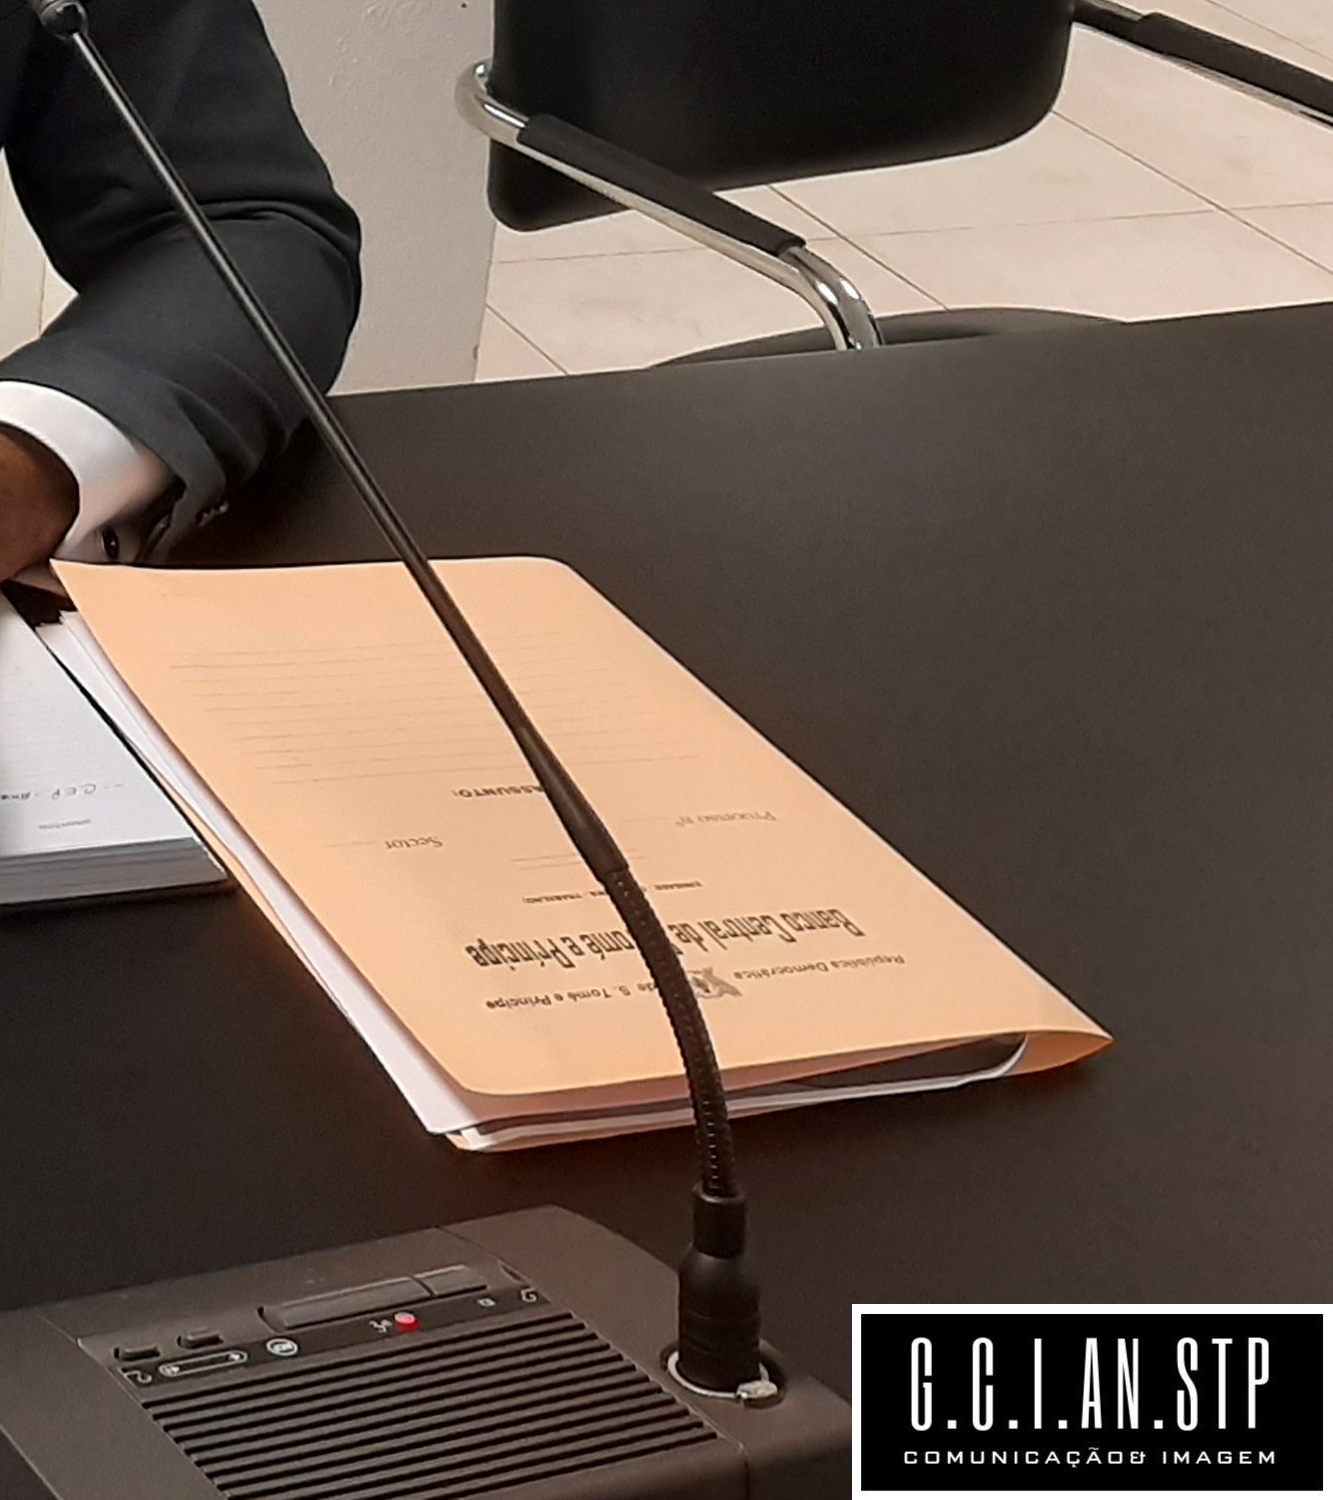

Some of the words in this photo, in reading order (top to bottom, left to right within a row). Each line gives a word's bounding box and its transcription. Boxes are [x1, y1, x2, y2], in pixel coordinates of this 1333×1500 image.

[452, 786, 543, 798] ASSUNTO:
[385, 836, 443, 850] Sector
[698, 914, 797, 950] Central
[780, 909, 865, 937] Banco
[560, 936, 583, 956] e
[580, 929, 635, 960] omé
[667, 923, 708, 952] de
[465, 937, 575, 971] Príncipe
[733, 962, 829, 980] Democrática
[554, 992, 564, 1002] e
[567, 988, 611, 1002] Tomé
